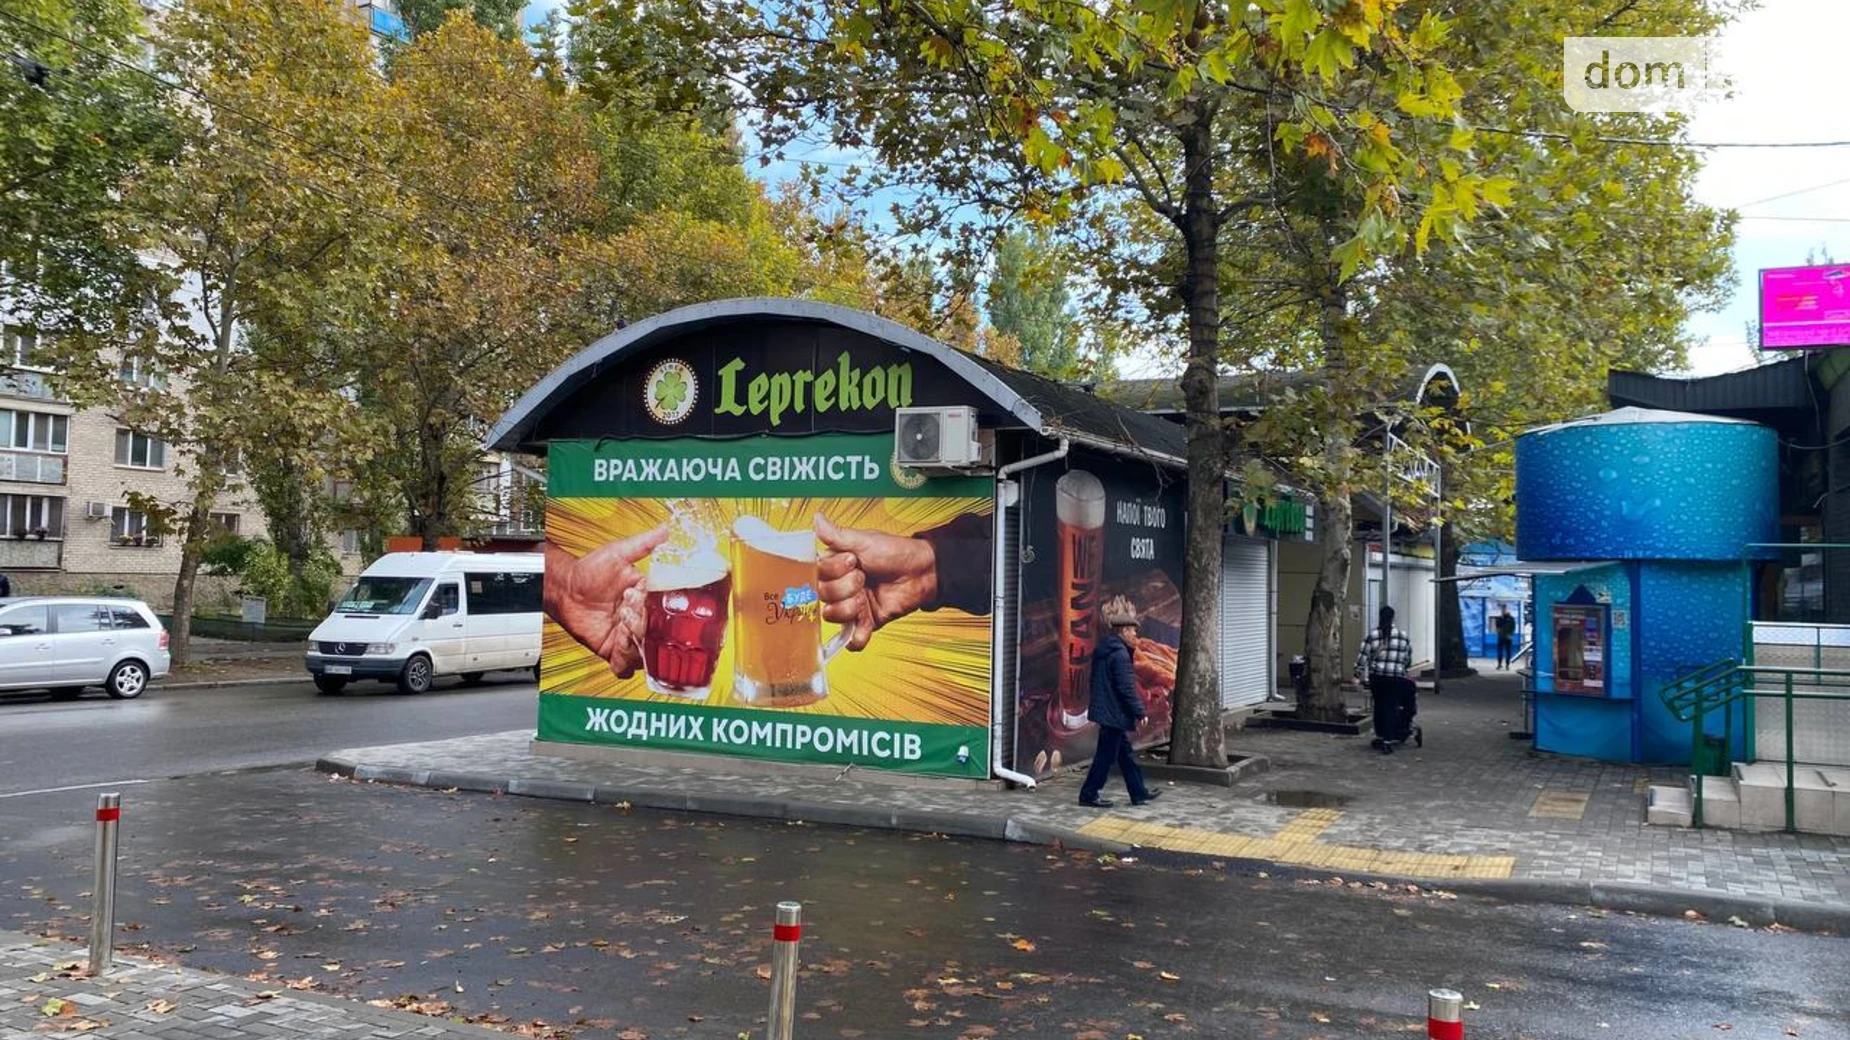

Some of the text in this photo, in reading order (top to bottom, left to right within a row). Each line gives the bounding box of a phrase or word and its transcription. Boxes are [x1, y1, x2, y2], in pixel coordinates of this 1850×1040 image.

[715, 350, 913, 426] Leprekon
[593, 455, 880, 482] ВРАЖАЮЧА СВІЖІСТЬ
[1116, 498, 1166, 529] НАПОЇ ТВОГО
[1130, 537, 1155, 560] СВЯТА
[585, 706, 922, 761] ЖОДНИХ КОМПРОМІСІВ
